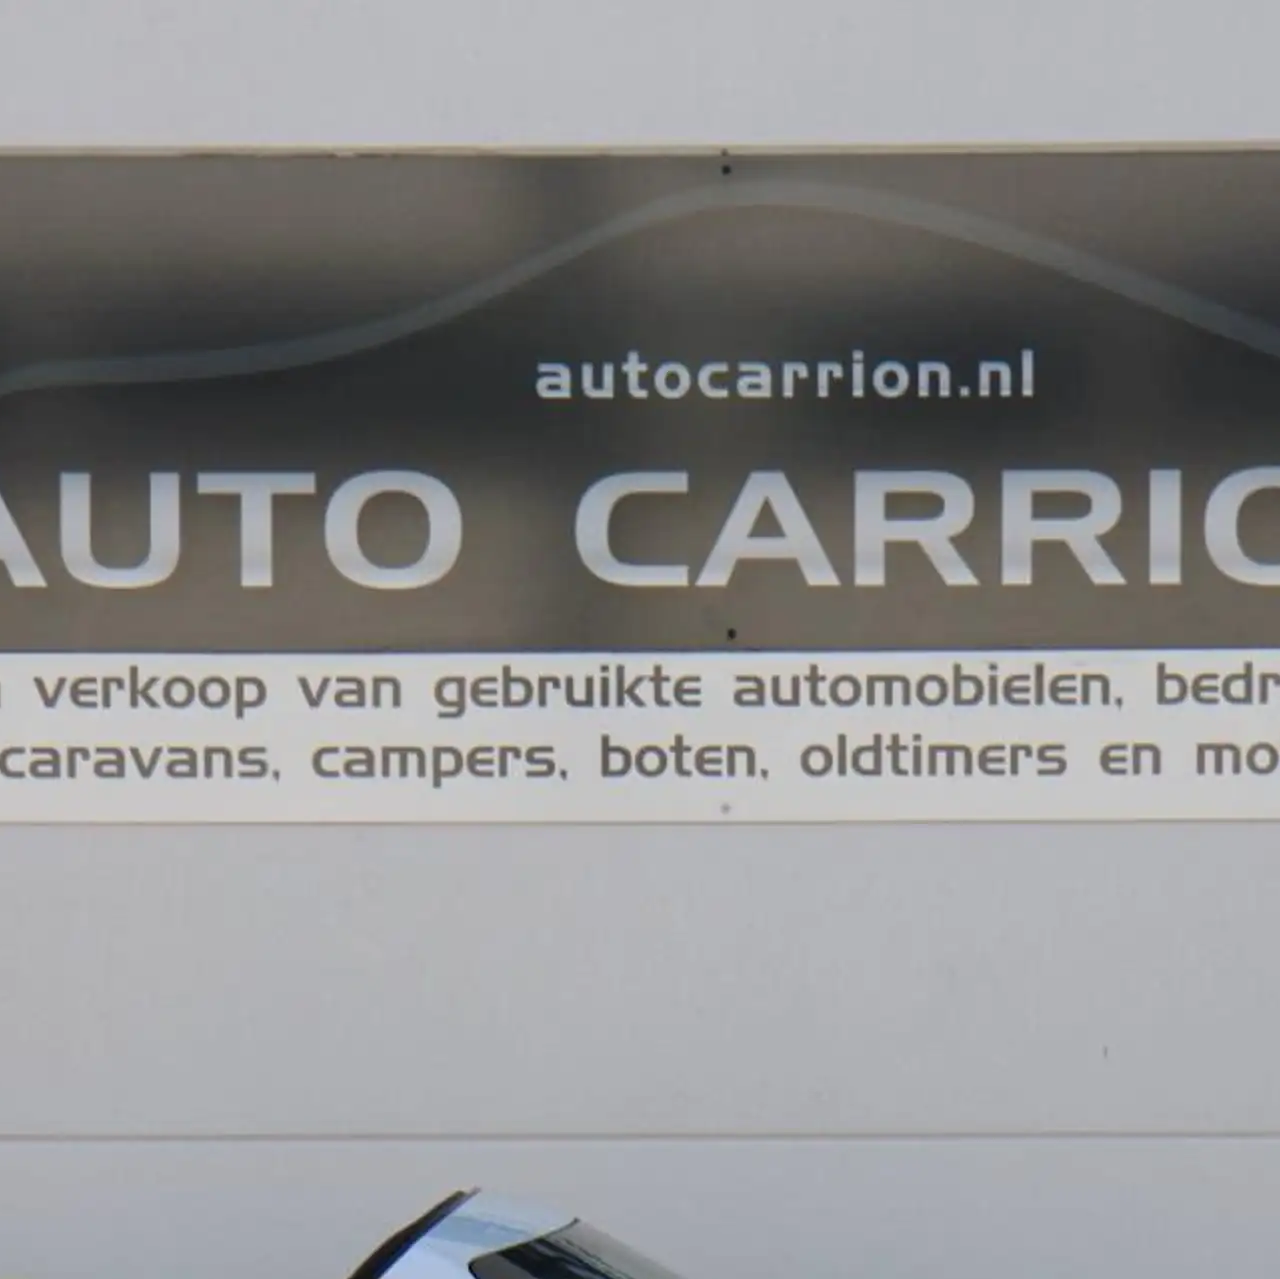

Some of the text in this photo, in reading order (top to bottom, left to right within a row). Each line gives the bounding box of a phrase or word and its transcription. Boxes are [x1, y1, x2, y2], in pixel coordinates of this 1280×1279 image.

[534, 348, 1036, 403] autocarrion.nl
[32, 665, 268, 720] verkoop
[297, 676, 403, 710] van
[433, 663, 703, 720] gebruikte
[732, 661, 1124, 710] automobielen,
[311, 744, 570, 790] campers,
[599, 734, 771, 781] boten,
[799, 731, 1069, 778] oldtimers
[1098, 742, 1163, 777] en
